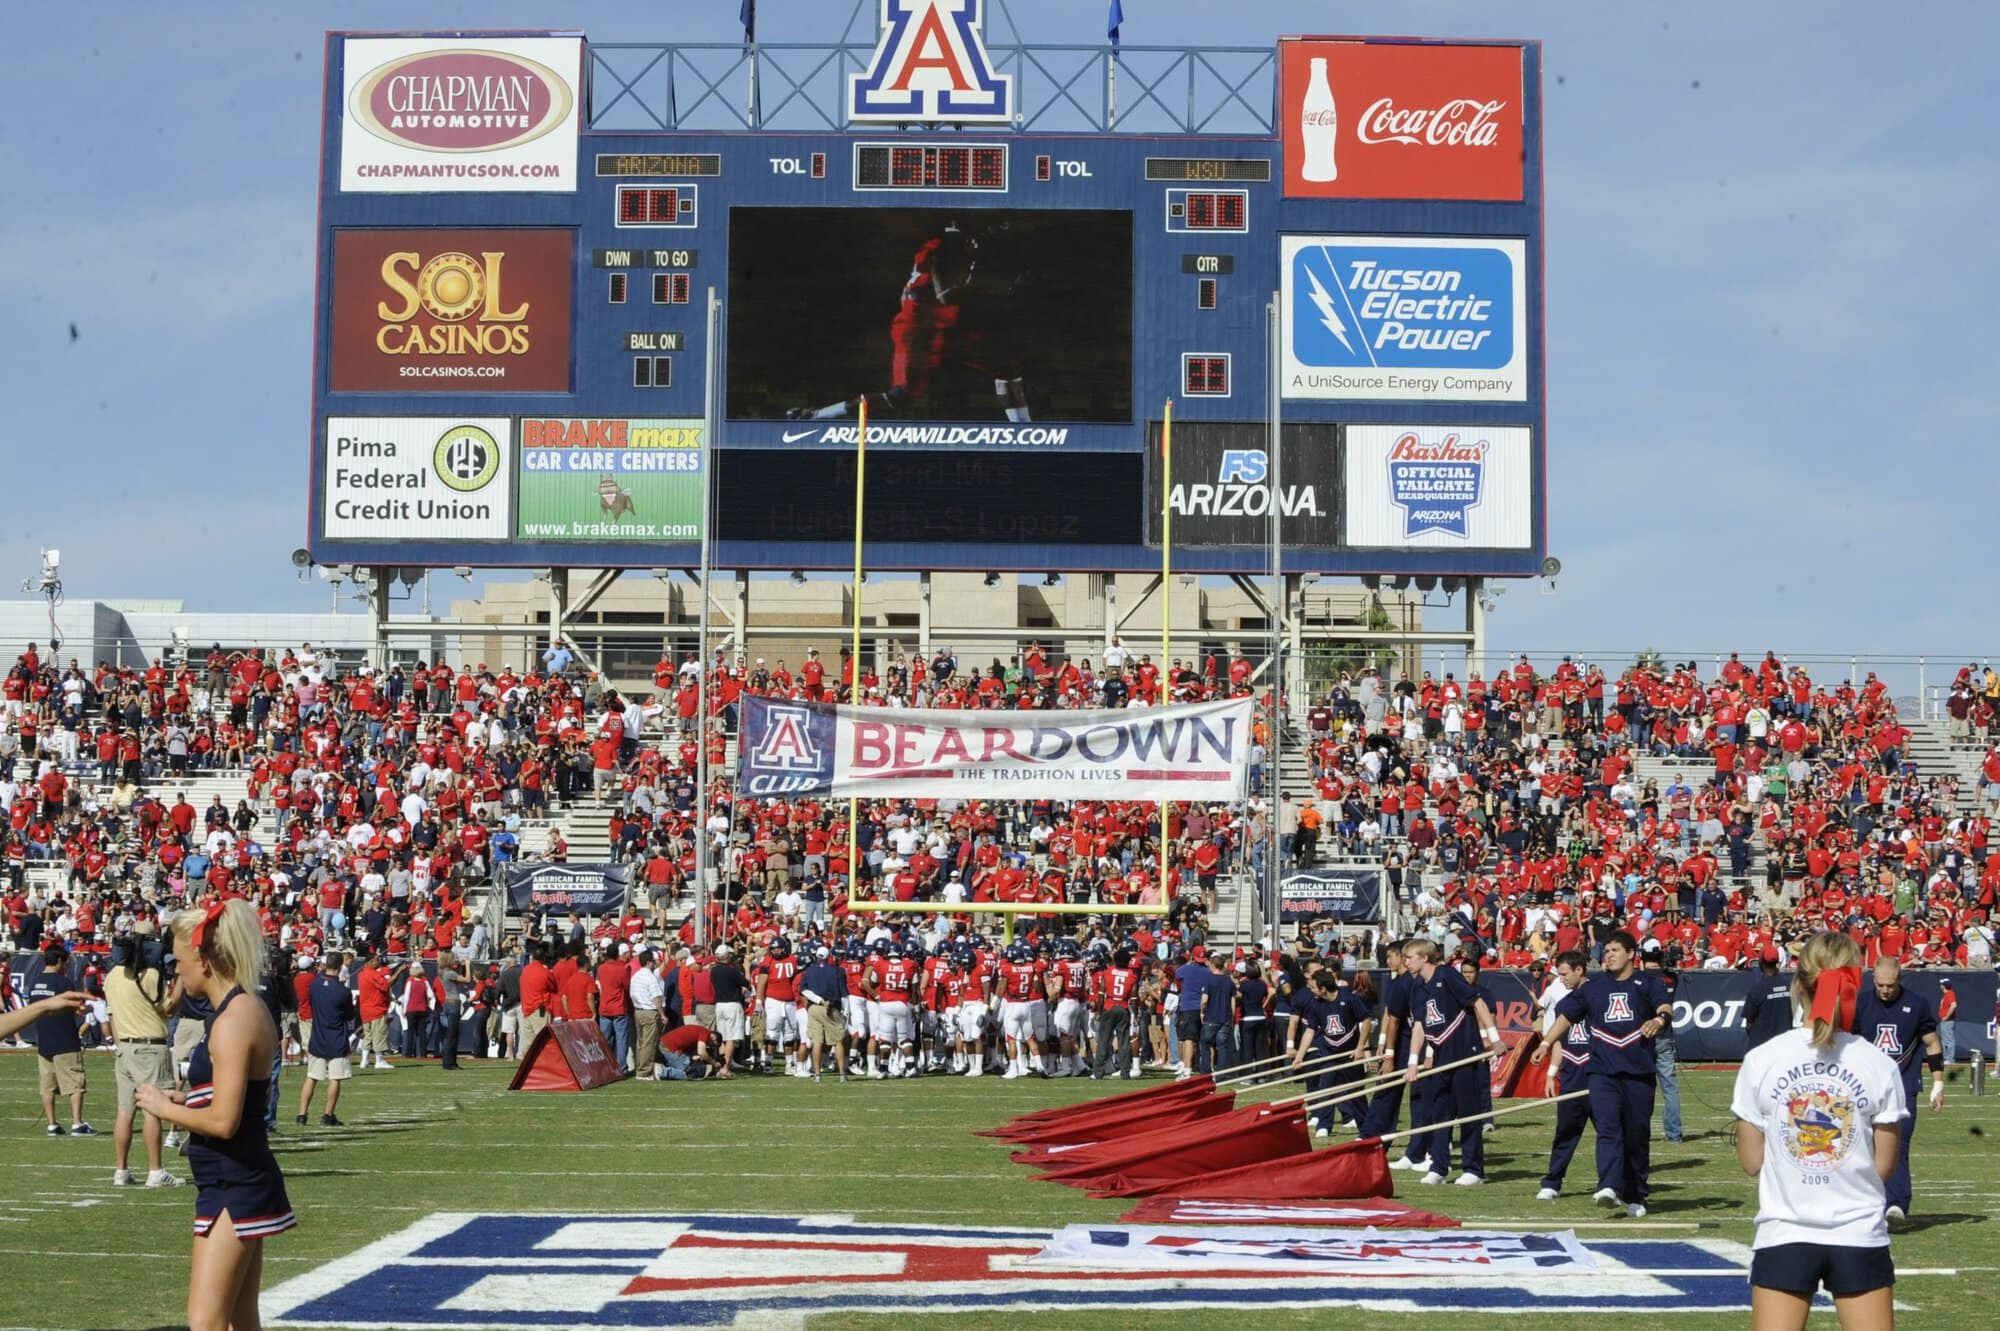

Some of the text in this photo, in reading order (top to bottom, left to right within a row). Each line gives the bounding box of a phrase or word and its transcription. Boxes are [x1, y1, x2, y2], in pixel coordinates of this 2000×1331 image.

[387, 74, 533, 114] CHAPMAN
[390, 114, 529, 128] AUTOMOTIVE
[1357, 97, 1507, 147] Coca-Cola
[357, 163, 560, 178] CHAPMANTUCSON.COM
[617, 157, 700, 175] ARIZONA
[770, 158, 806, 174] TOL
[1056, 161, 1092, 178] TOL
[1187, 161, 1226, 179] WSU
[606, 251, 630, 266] DWN
[655, 252, 688, 266] TO GO
[1197, 257, 1218, 272] QTR
[1349, 260, 1462, 292] Tucson
[377, 250, 530, 323] SOL
[1360, 293, 1492, 322] Electric
[376, 325, 530, 355] CASINOS
[631, 335, 676, 350] BALL ON
[1373, 321, 1492, 351] Power
[399, 366, 506, 378] SOLCASINOS.COM
[1292, 375, 1513, 393] A UniSource Energy Company
[523, 420, 703, 449] BRAKE max
[819, 426, 1068, 447] ARIZONAWILDCATS.COM
[336, 437, 396, 457] Pima
[1391, 435, 1486, 462] Bashas'
[526, 452, 699, 471] CAR CARE CENTERS
[1219, 449, 1269, 484] FS
[336, 468, 426, 489] Federal
[1397, 466, 1475, 479] OFFICIAL
[1397, 481, 1475, 492] TAILGATE
[1162, 484, 1317, 517] ARIZONA
[1398, 492, 1475, 502] HEADQUARTERS
[335, 499, 490, 520] Credit Union
[1411, 510, 1462, 521] ARIZONA
[525, 521, 697, 537] www.brakemax.com
[751, 705, 822, 772] A
[750, 774, 820, 794] CLUB
[959, 768, 1122, 781] THE TRADITION LIVES
[1281, 899, 1321, 913] Family
[776, 963, 794, 979] 70
[886, 973, 908, 991] 54
[1019, 974, 1029, 994] 2
[1426, 999, 1446, 1027] A
[1604, 992, 1634, 1023] A
[1325, 1014, 1346, 1035] A
[1873, 1024, 1902, 1055] A
[1770, 1062, 1869, 1109] HOMECOMING
[1802, 1174, 1830, 1184] 2009
